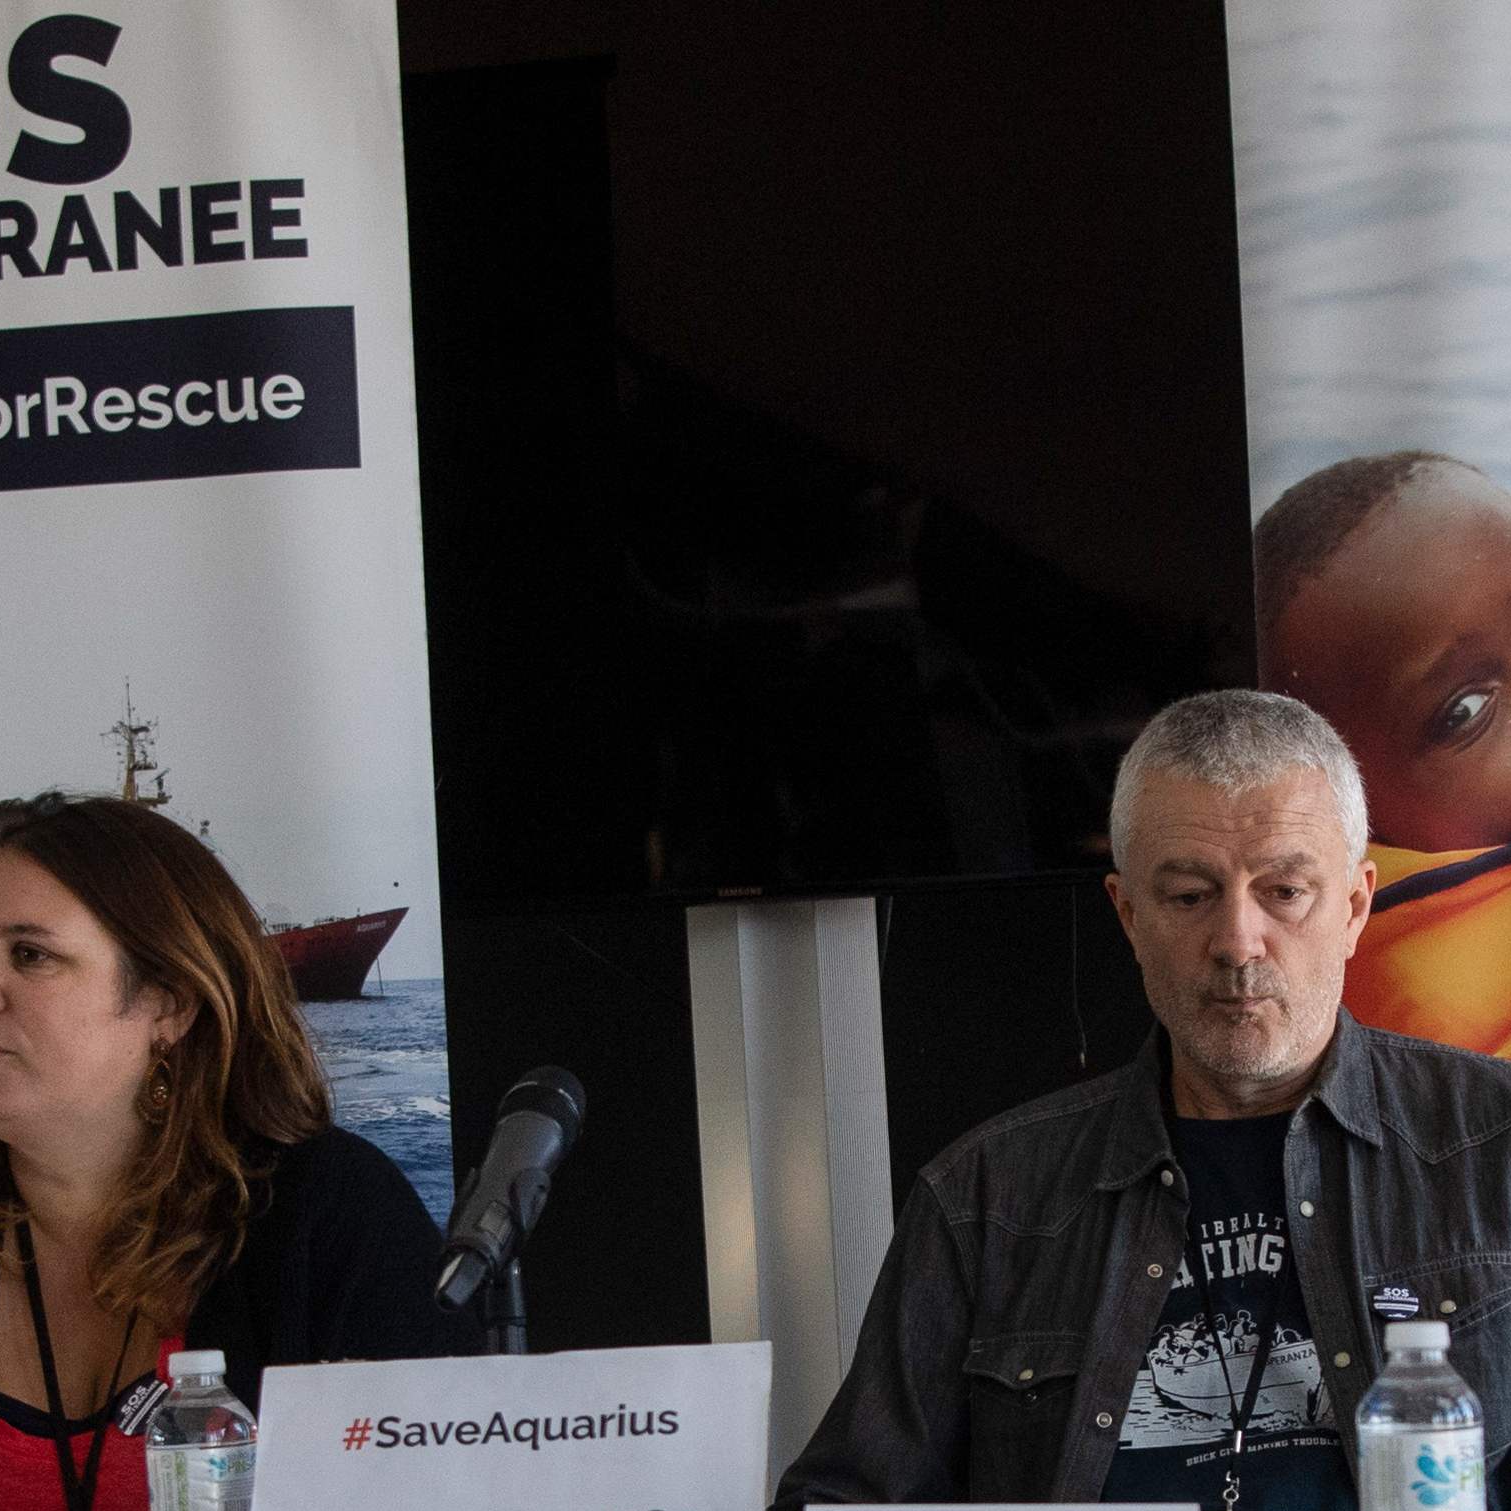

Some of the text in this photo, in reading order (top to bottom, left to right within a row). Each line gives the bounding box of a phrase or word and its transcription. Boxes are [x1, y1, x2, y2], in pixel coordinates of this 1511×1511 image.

[1200, 1212, 1285, 1239] IBRALT
[1383, 1287, 1410, 1297] SOS
[120, 1385, 147, 1416] SOS
[343, 1403, 680, 1451] #SaveAquarius
